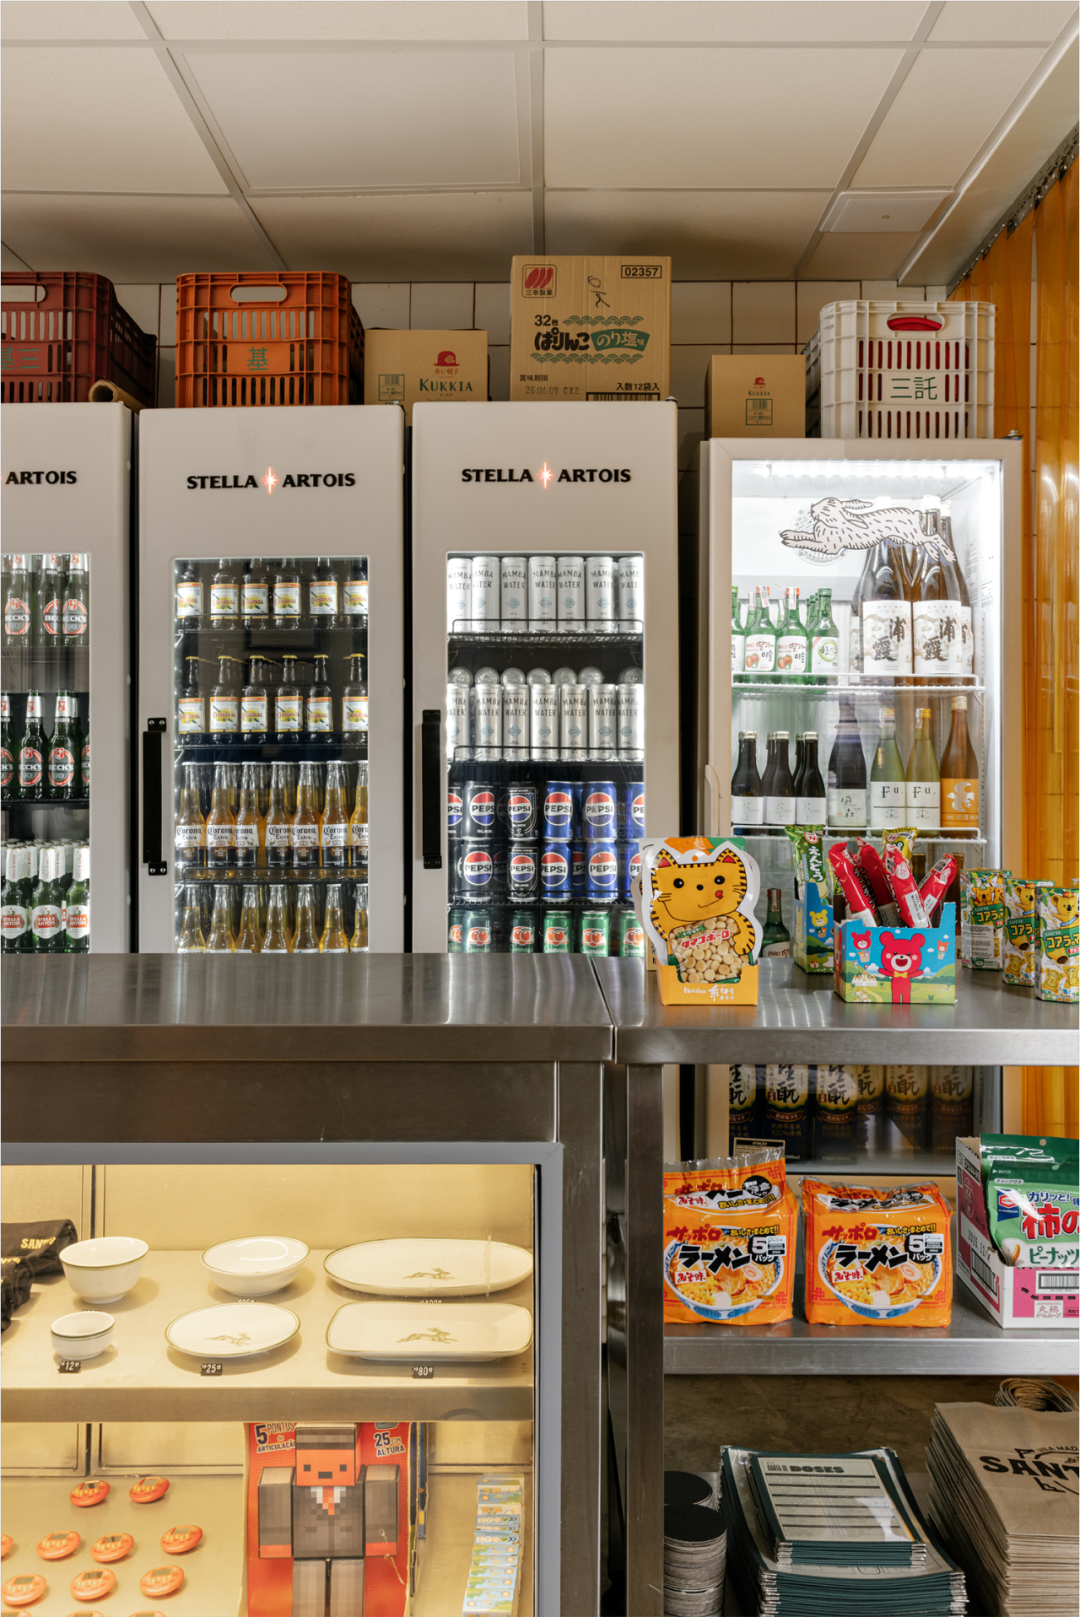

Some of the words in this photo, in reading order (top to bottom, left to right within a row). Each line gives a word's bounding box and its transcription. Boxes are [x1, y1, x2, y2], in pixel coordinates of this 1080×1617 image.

[624, 267, 658, 276] 02357
[534, 315, 558, 326] 32枚
[534, 327, 590, 350] ぱりんこ
[596, 331, 644, 347] のり塩味
[248, 346, 268, 370] 基
[520, 374, 548, 382] 賞味期限
[420, 378, 472, 391] KUKKIA
[616, 383, 660, 391] 入数12袋入
[890, 376, 938, 400] 三託
[6, 471, 77, 484] ARTOIS
[462, 469, 534, 482] STELLA
[558, 469, 631, 482] ARTOIS
[186, 475, 258, 489] STELLA
[282, 473, 356, 488] ARTOIS
[502, 570, 526, 579] MAMBA
[558, 570, 582, 578] MAMBA
[503, 581, 526, 589] WATER
[560, 581, 580, 589] WATER
[504, 698, 528, 706] MAMBA
[534, 698, 556, 706] MAMBA
[563, 698, 586, 706] MAMBA
[545, 805, 572, 813] PEPSI
[176, 827, 202, 835] Corona
[208, 826, 233, 835] Corona
[234, 827, 254, 835] orona
[269, 827, 290, 836] Coron
[292, 827, 317, 835] Corona
[808, 846, 823, 881] えんどう
[541, 865, 566, 873] PEPSI
[680, 929, 730, 949] タマゴボーロ
[666, 1224, 723, 1241] サッポロ
[822, 1222, 878, 1240] サッポロ
[678, 1245, 750, 1274] ラーメン
[755, 1254, 774, 1262] パック
[835, 1244, 908, 1273] ラーメン
[676, 1272, 706, 1282] みそ味
[834, 1270, 863, 1281] みそ味
[255, 1424, 268, 1444] 5
[374, 1432, 390, 1447] 25
[377, 1444, 406, 1456] ALTURA
[790, 1465, 844, 1473] DOSES
